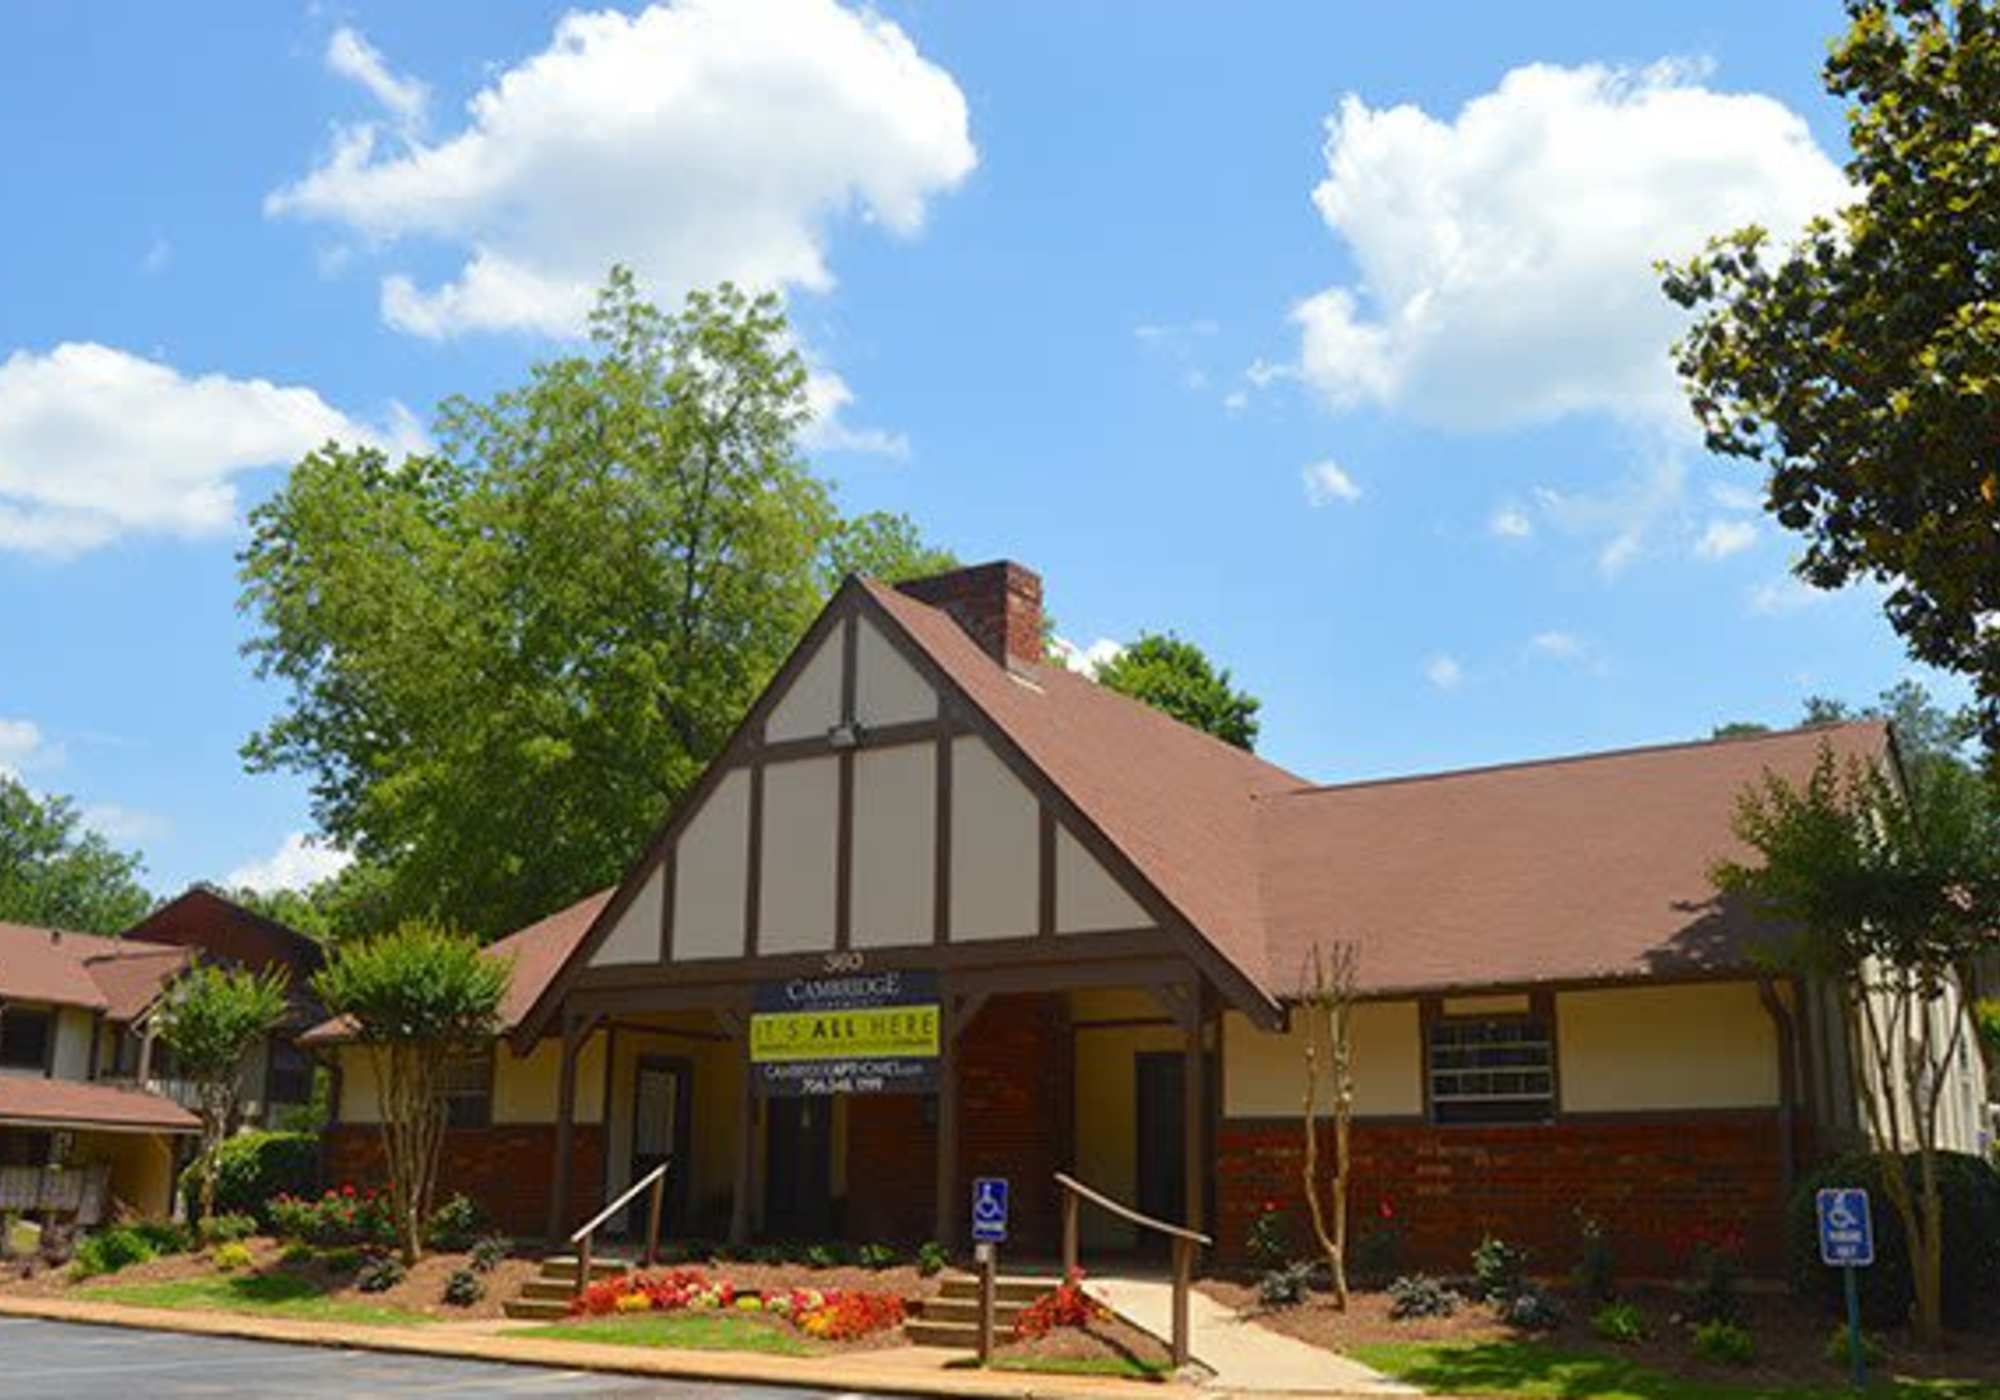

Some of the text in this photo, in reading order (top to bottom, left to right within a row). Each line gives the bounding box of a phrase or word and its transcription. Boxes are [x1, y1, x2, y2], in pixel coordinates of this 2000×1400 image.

[786, 973, 899, 1001] CAMBRIDGE
[813, 1018, 854, 1038] ALL
[870, 1013, 934, 1036] HERE
